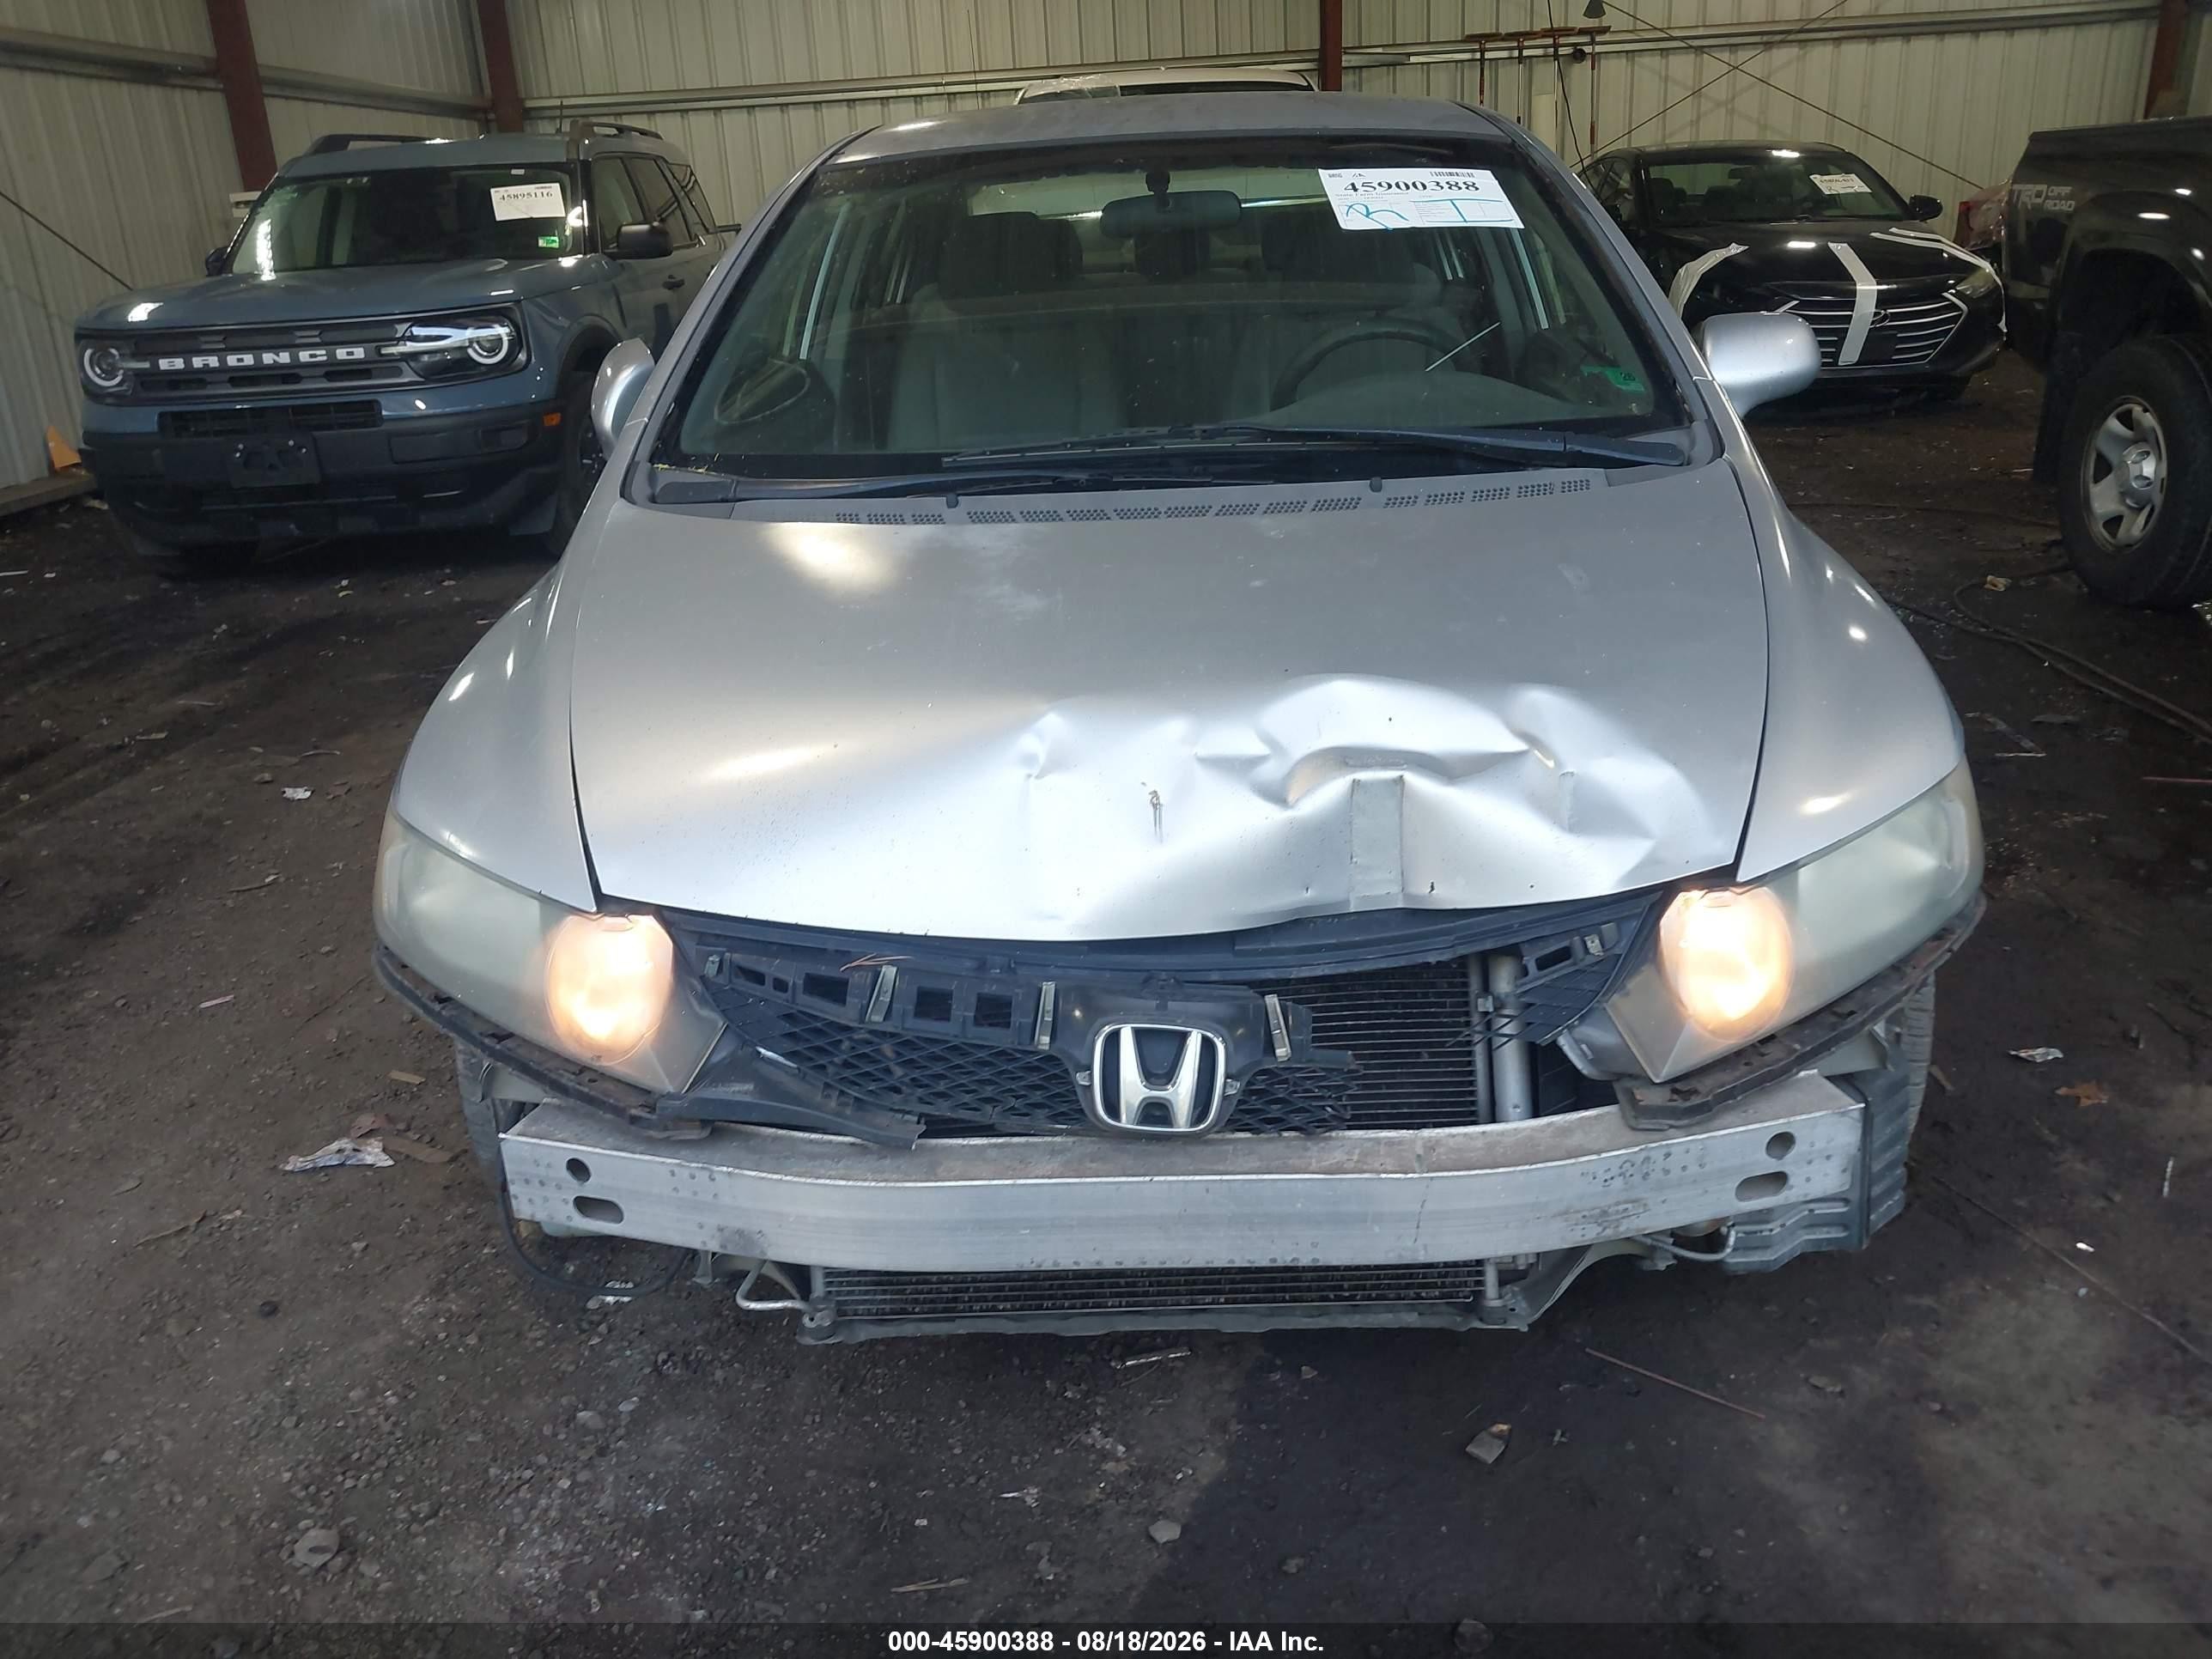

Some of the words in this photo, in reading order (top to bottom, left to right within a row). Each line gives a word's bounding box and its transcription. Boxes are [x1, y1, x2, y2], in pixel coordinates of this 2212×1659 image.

[1343, 179, 1480, 193] 45900388
[499, 191, 554, 201] 45895116
[2013, 184, 2048, 210] TRD
[2048, 185, 2073, 196] OFF
[2044, 200, 2075, 211] ROAD
[158, 347, 366, 371] BRONCO
